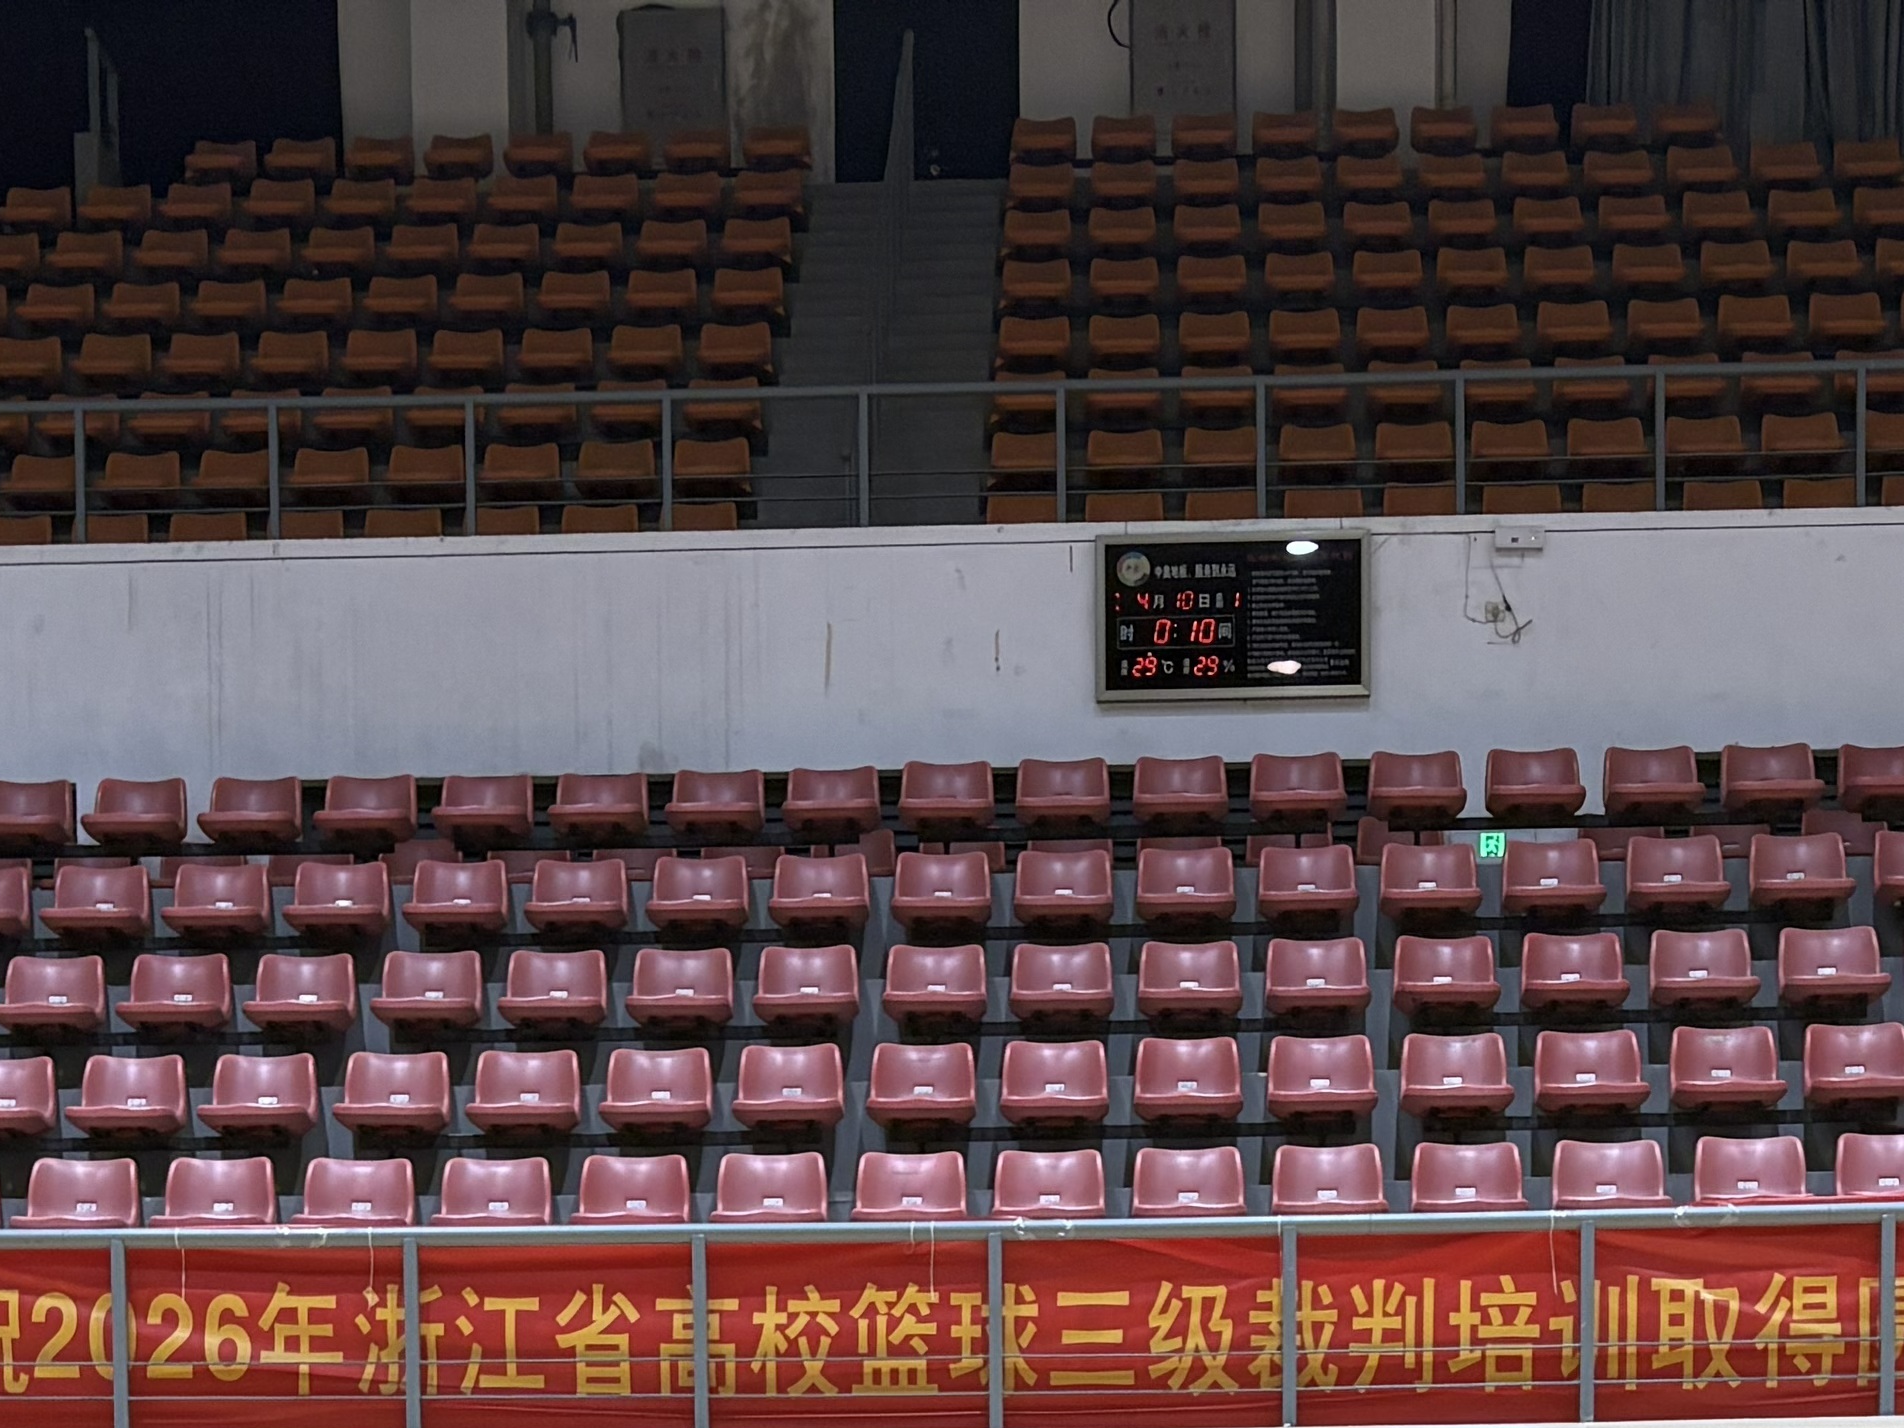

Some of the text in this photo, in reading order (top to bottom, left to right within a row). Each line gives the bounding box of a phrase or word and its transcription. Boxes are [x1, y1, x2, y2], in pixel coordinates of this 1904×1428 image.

[1119, 618, 1233, 645] 时 0:10 间
